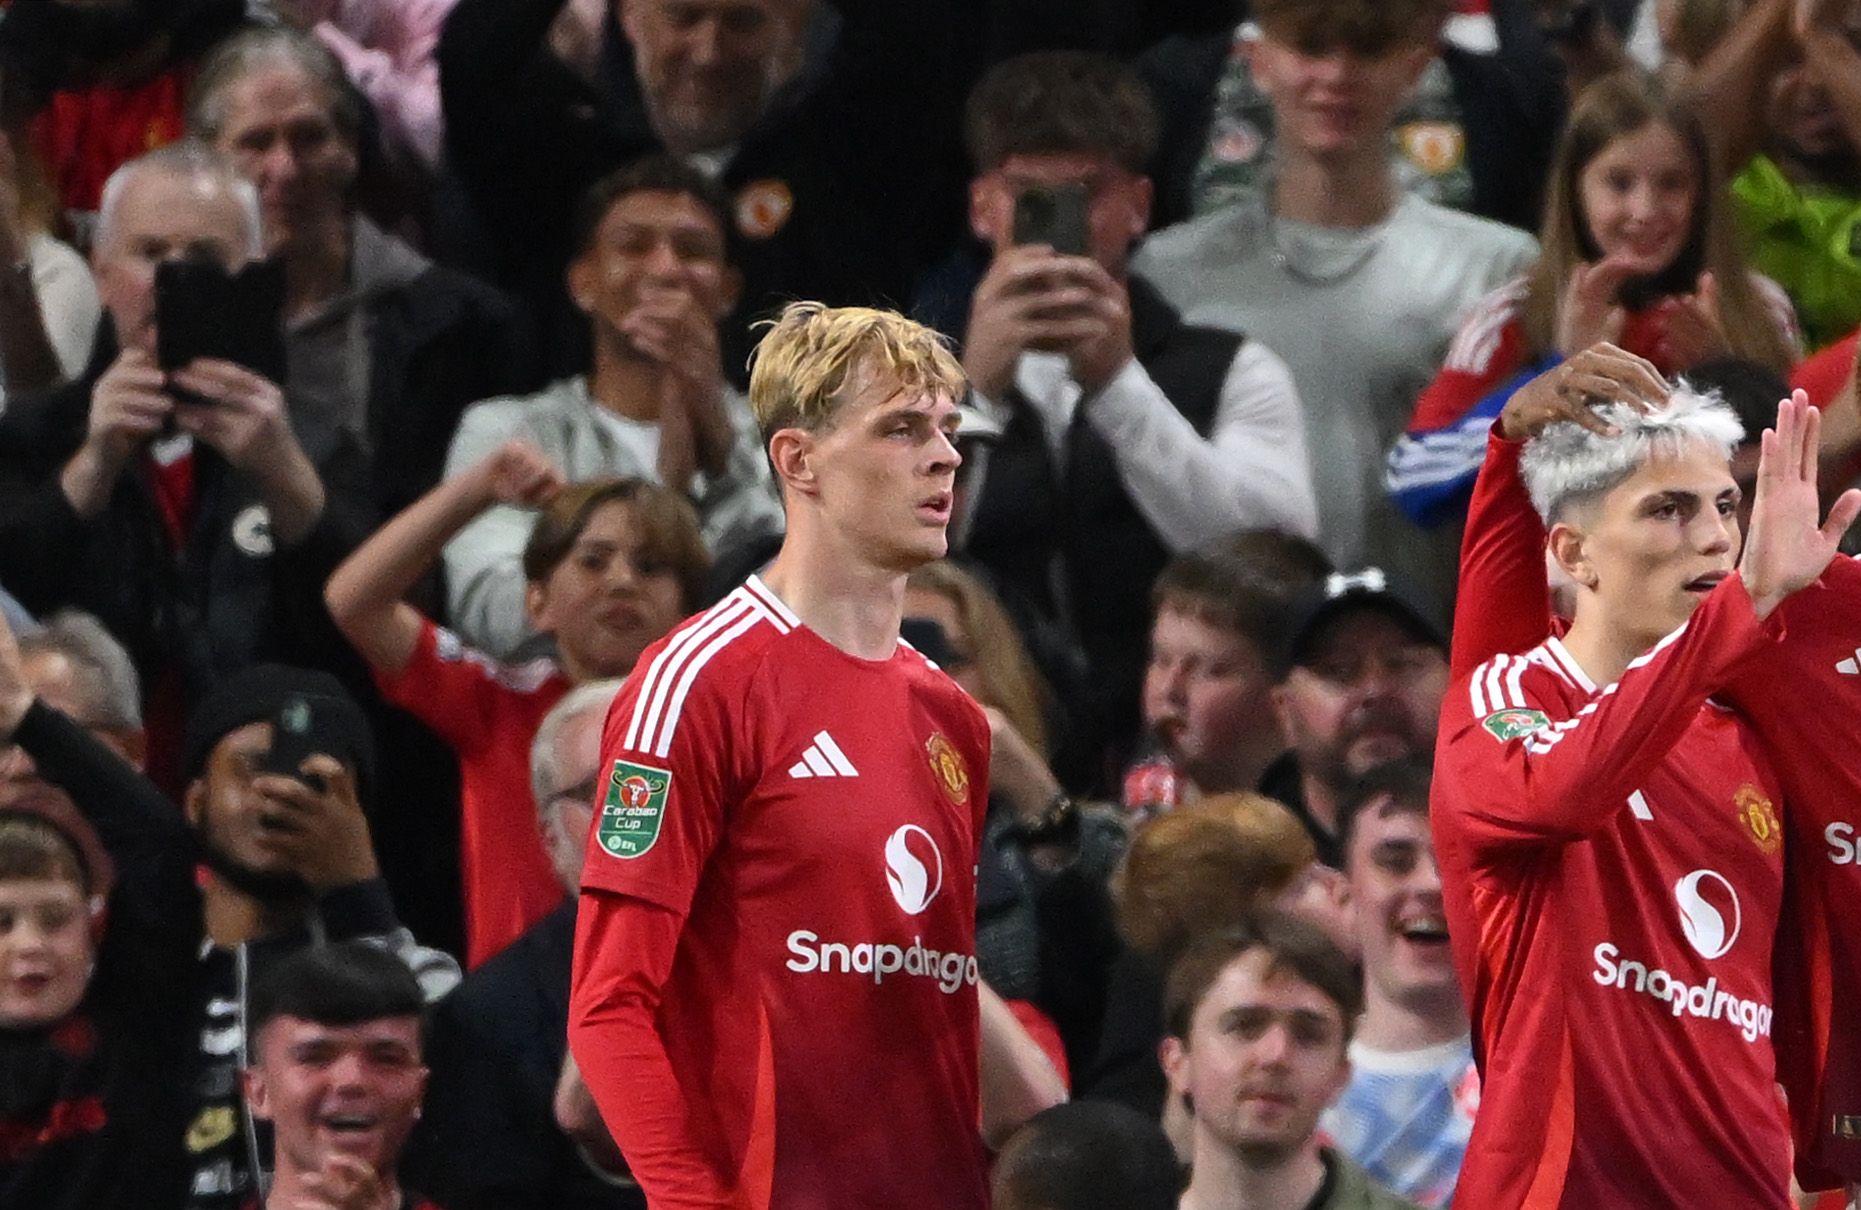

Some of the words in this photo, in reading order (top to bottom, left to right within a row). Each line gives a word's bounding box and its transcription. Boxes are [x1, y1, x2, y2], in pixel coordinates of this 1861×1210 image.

[603, 804, 658, 817] Carabao
[615, 817, 642, 830] Cup
[786, 929, 980, 995] Snapdrago
